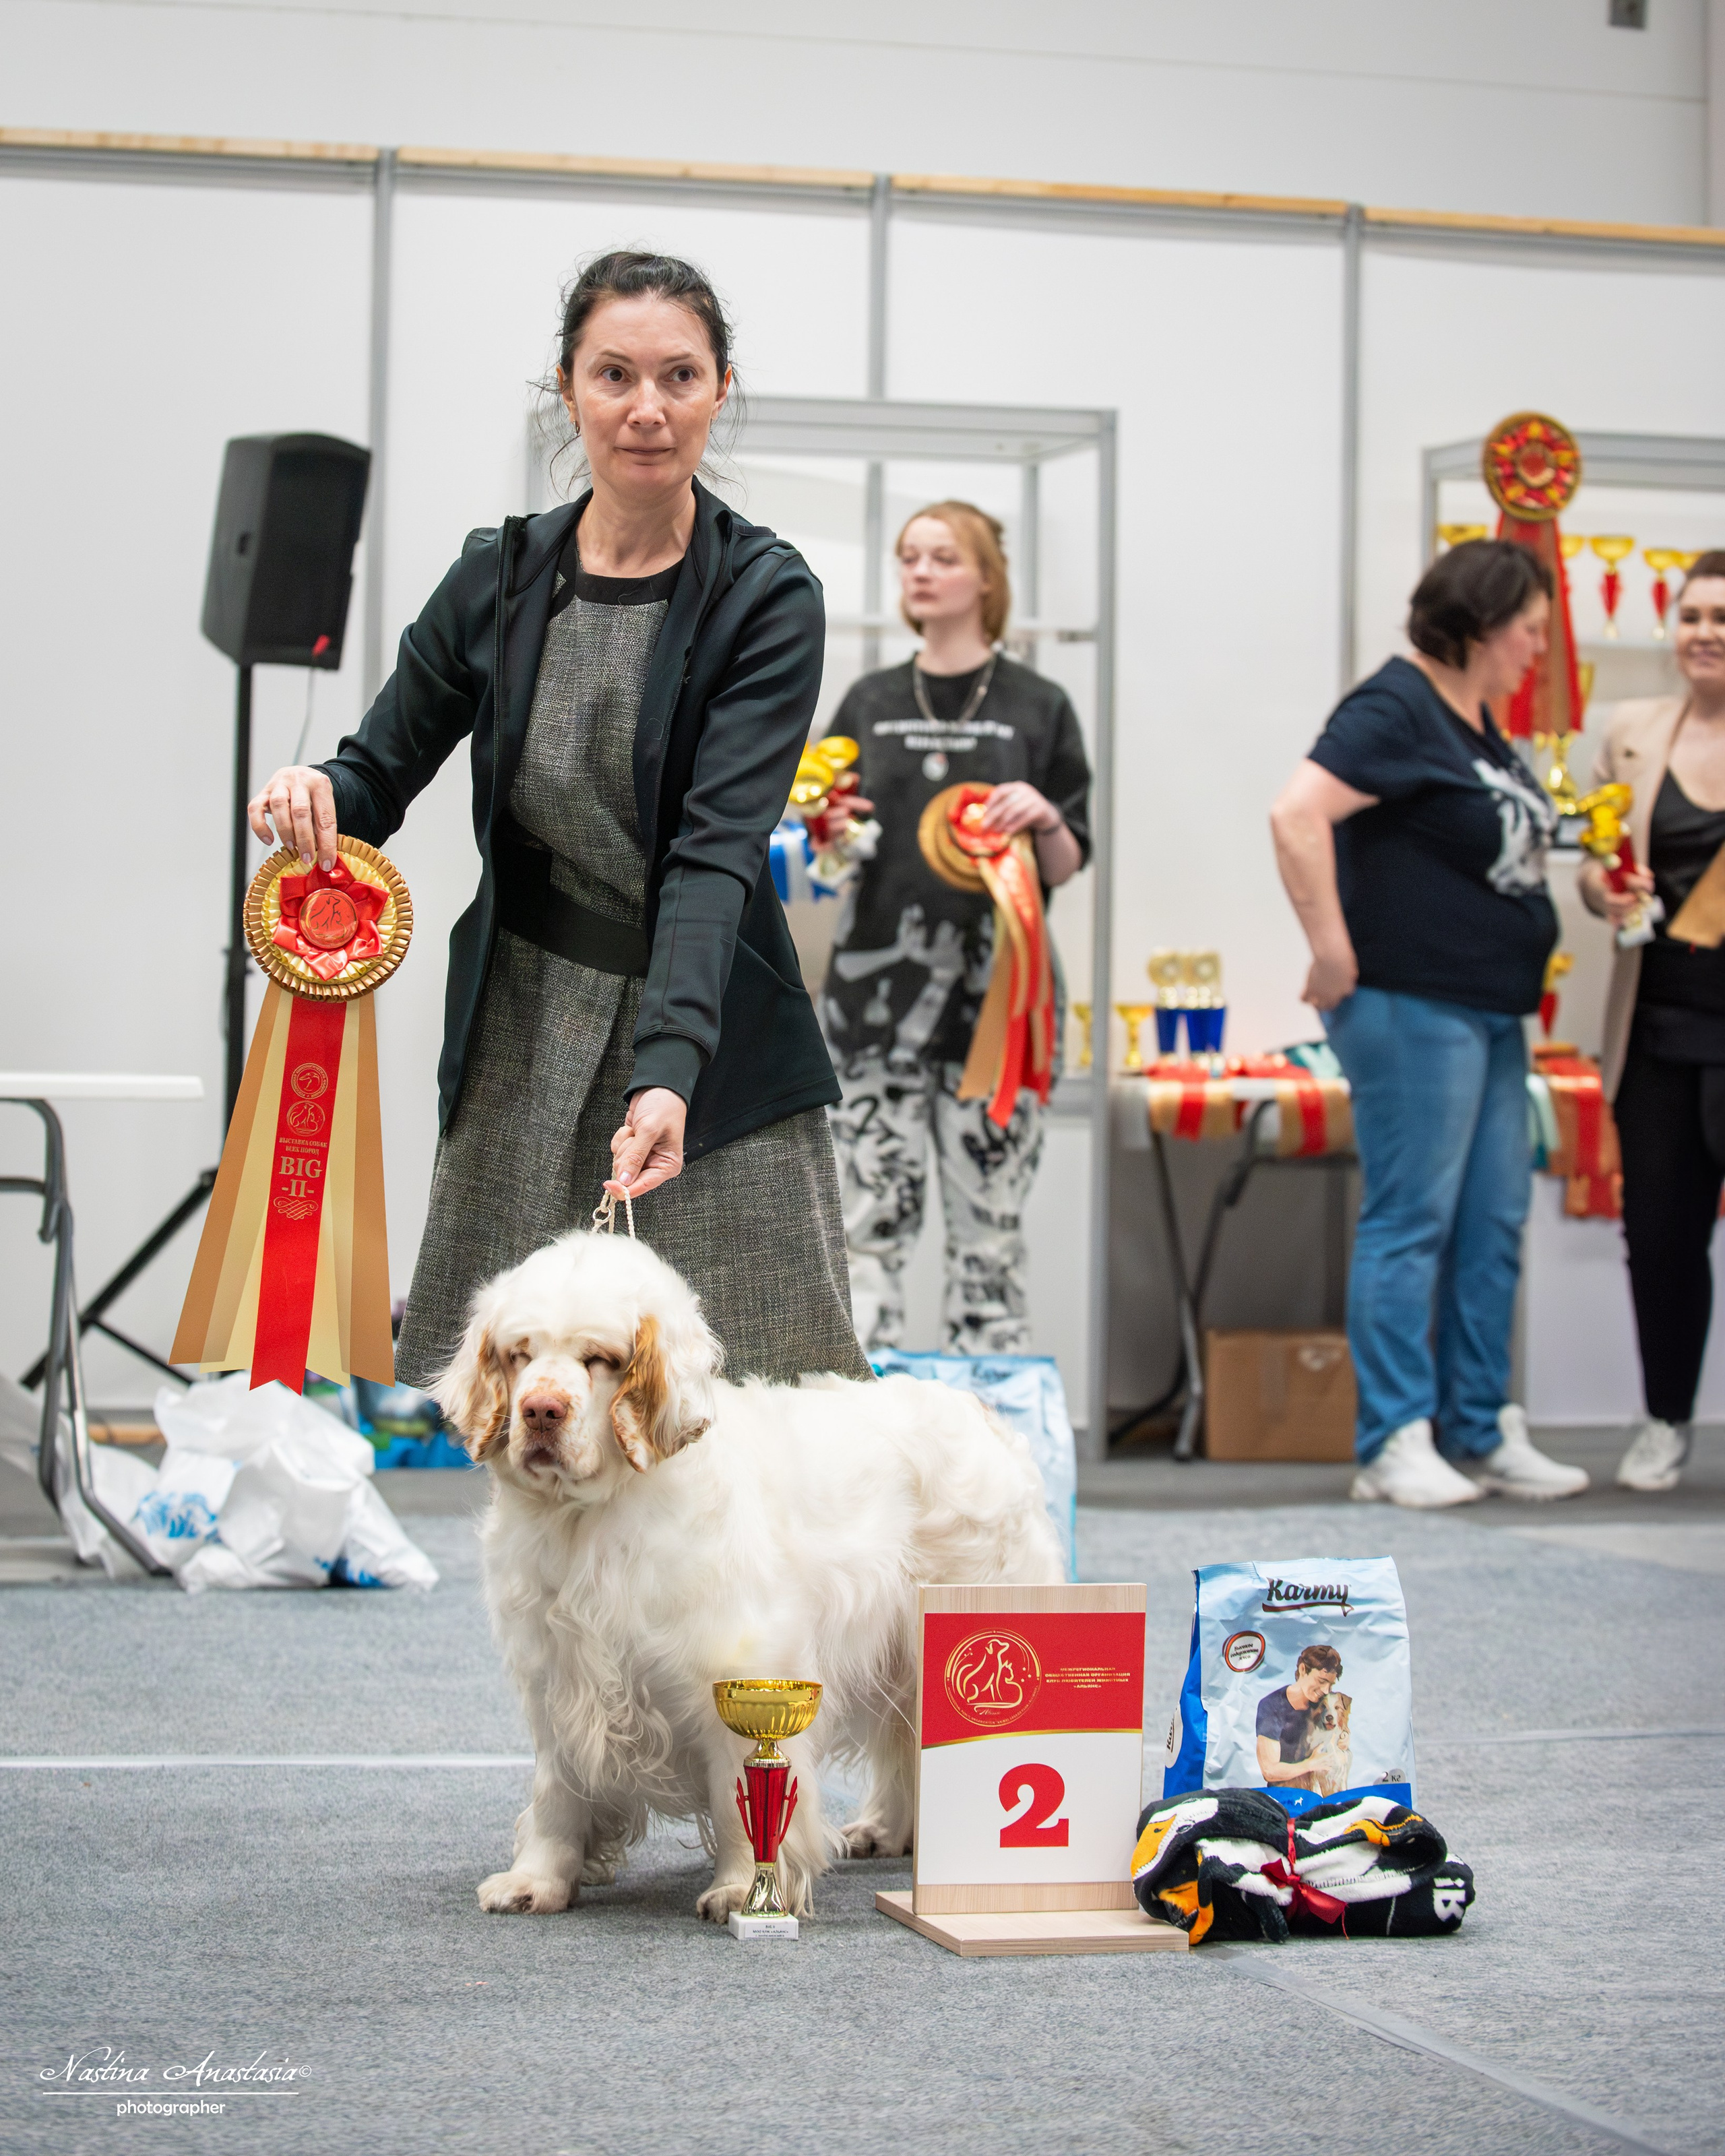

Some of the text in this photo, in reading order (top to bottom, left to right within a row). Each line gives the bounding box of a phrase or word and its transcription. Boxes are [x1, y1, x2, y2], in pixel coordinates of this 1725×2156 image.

[279, 1137, 308, 1145] ВЫСТАВКА
[301, 1147, 319, 1156] ПОРОД
[279, 1155, 322, 1178] BIG
[1263, 1577, 1351, 1617] Karmy
[1382, 1771, 1389, 1782] 2
[999, 1763, 1069, 1848] 2
